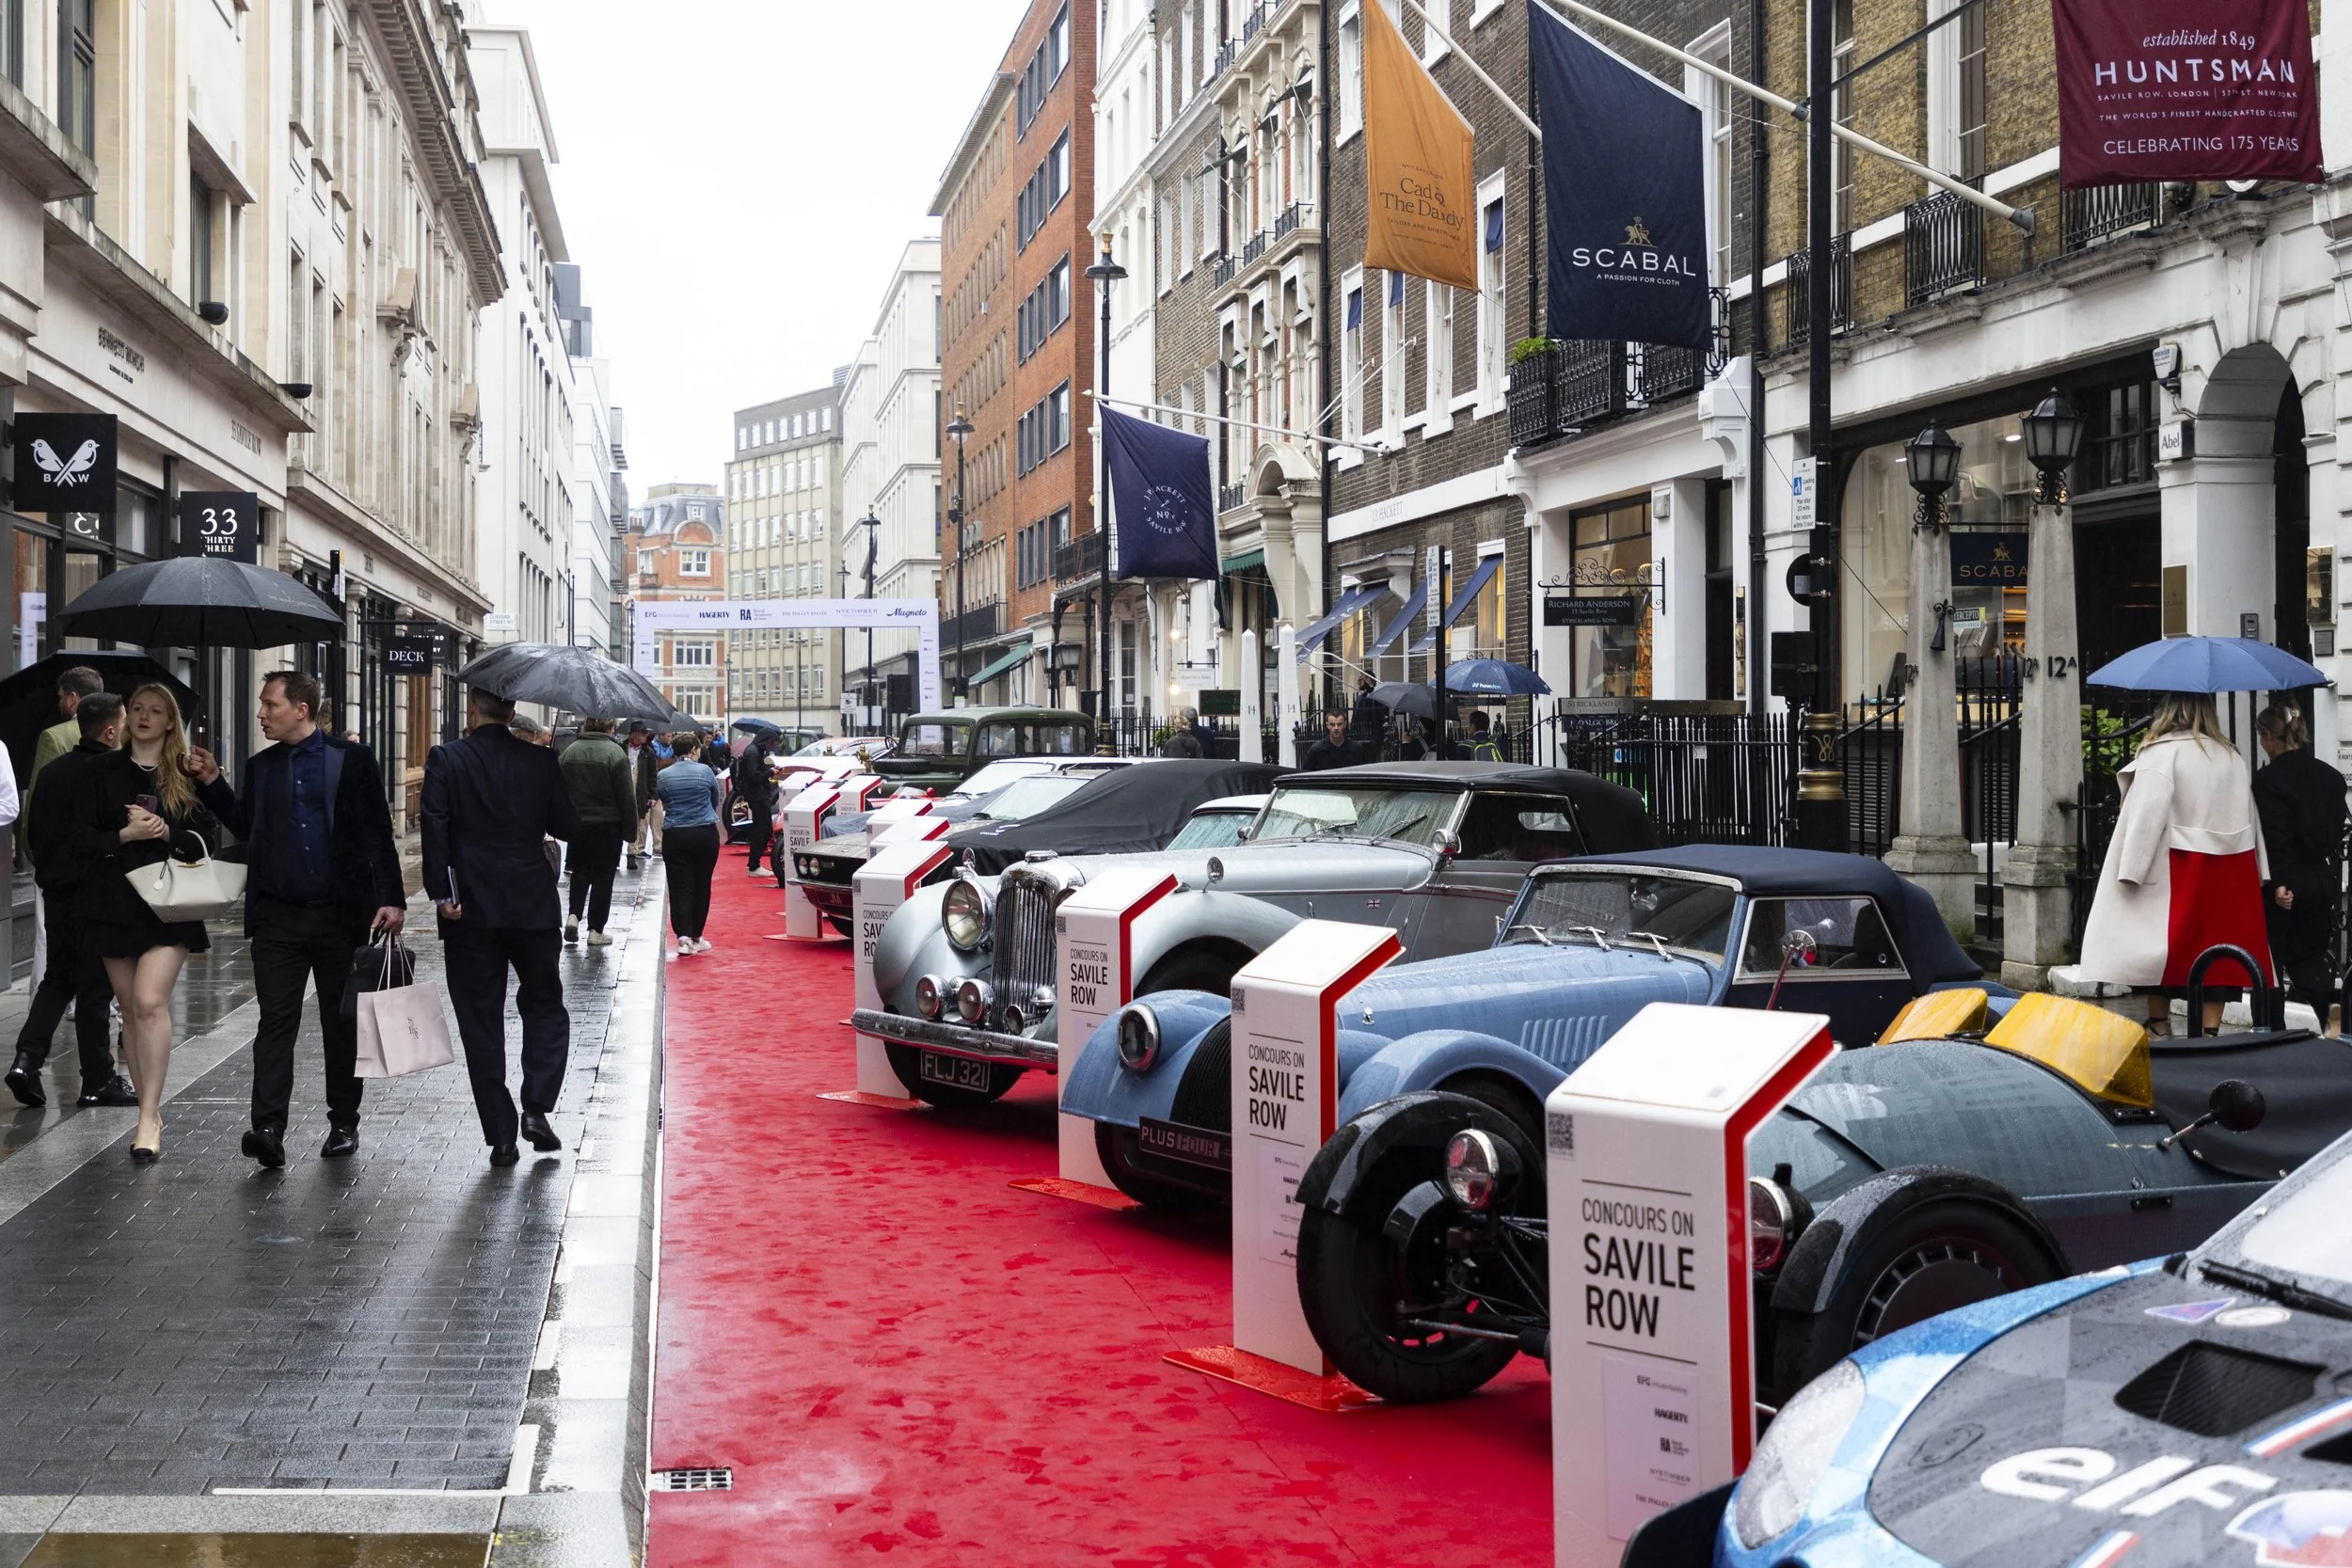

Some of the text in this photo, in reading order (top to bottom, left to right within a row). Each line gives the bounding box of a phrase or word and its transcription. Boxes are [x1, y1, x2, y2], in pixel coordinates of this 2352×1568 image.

[2142, 29, 2255, 51] established 1849
[2094, 58, 2295, 86] HUNTSMAN
[2097, 92, 2133, 102] SAVILE
[2168, 89, 2209, 98] LONDON
[2122, 111, 2167, 119] WORLD'S
[2204, 109, 2265, 118] HANDCRAFTED
[2104, 136, 2299, 154] CELEBRATING 175 YEARS
[1400, 177, 1433, 200] Cad
[1379, 191, 1415, 214] The
[1572, 247, 1696, 277] SCABAL
[1657, 277, 1680, 286] CLOTH
[2161, 432, 2180, 450] Abel
[43, 473, 89, 483] B W
[200, 508, 238, 535] 33
[1147, 516, 1173, 534] SAVILE
[1960, 565, 2028, 578] SCABA
[739, 609, 752, 621] RA
[886, 608, 928, 619] Magneto
[389, 650, 425, 662] DECK
[2047, 655, 2077, 678] 12A
[1568, 700, 1614, 708] STRICKLAND
[863, 909, 889, 921] CONCOURS
[1070, 948, 1108, 963] CONCOURS ON
[1071, 962, 1108, 986] SAVILE
[1071, 985, 1097, 1006] ROW
[1248, 1044, 1305, 1069] CONCOURS ON
[925, 1053, 985, 1087] FLJ 321
[1248, 1066, 1305, 1102] SAVILE
[1249, 1098, 1287, 1131] ROW
[1141, 1126, 1175, 1148] PLUS
[1581, 1197, 1694, 1237] CONCOURS ON
[1583, 1232, 1695, 1291] SAVILE
[1585, 1284, 1660, 1338] ROW
[1637, 1375, 1651, 1386] EFG
[1654, 1407, 1689, 1423] HAGERTY
[1661, 1437, 1671, 1452] RA
[1979, 1447, 2280, 1517] elf
